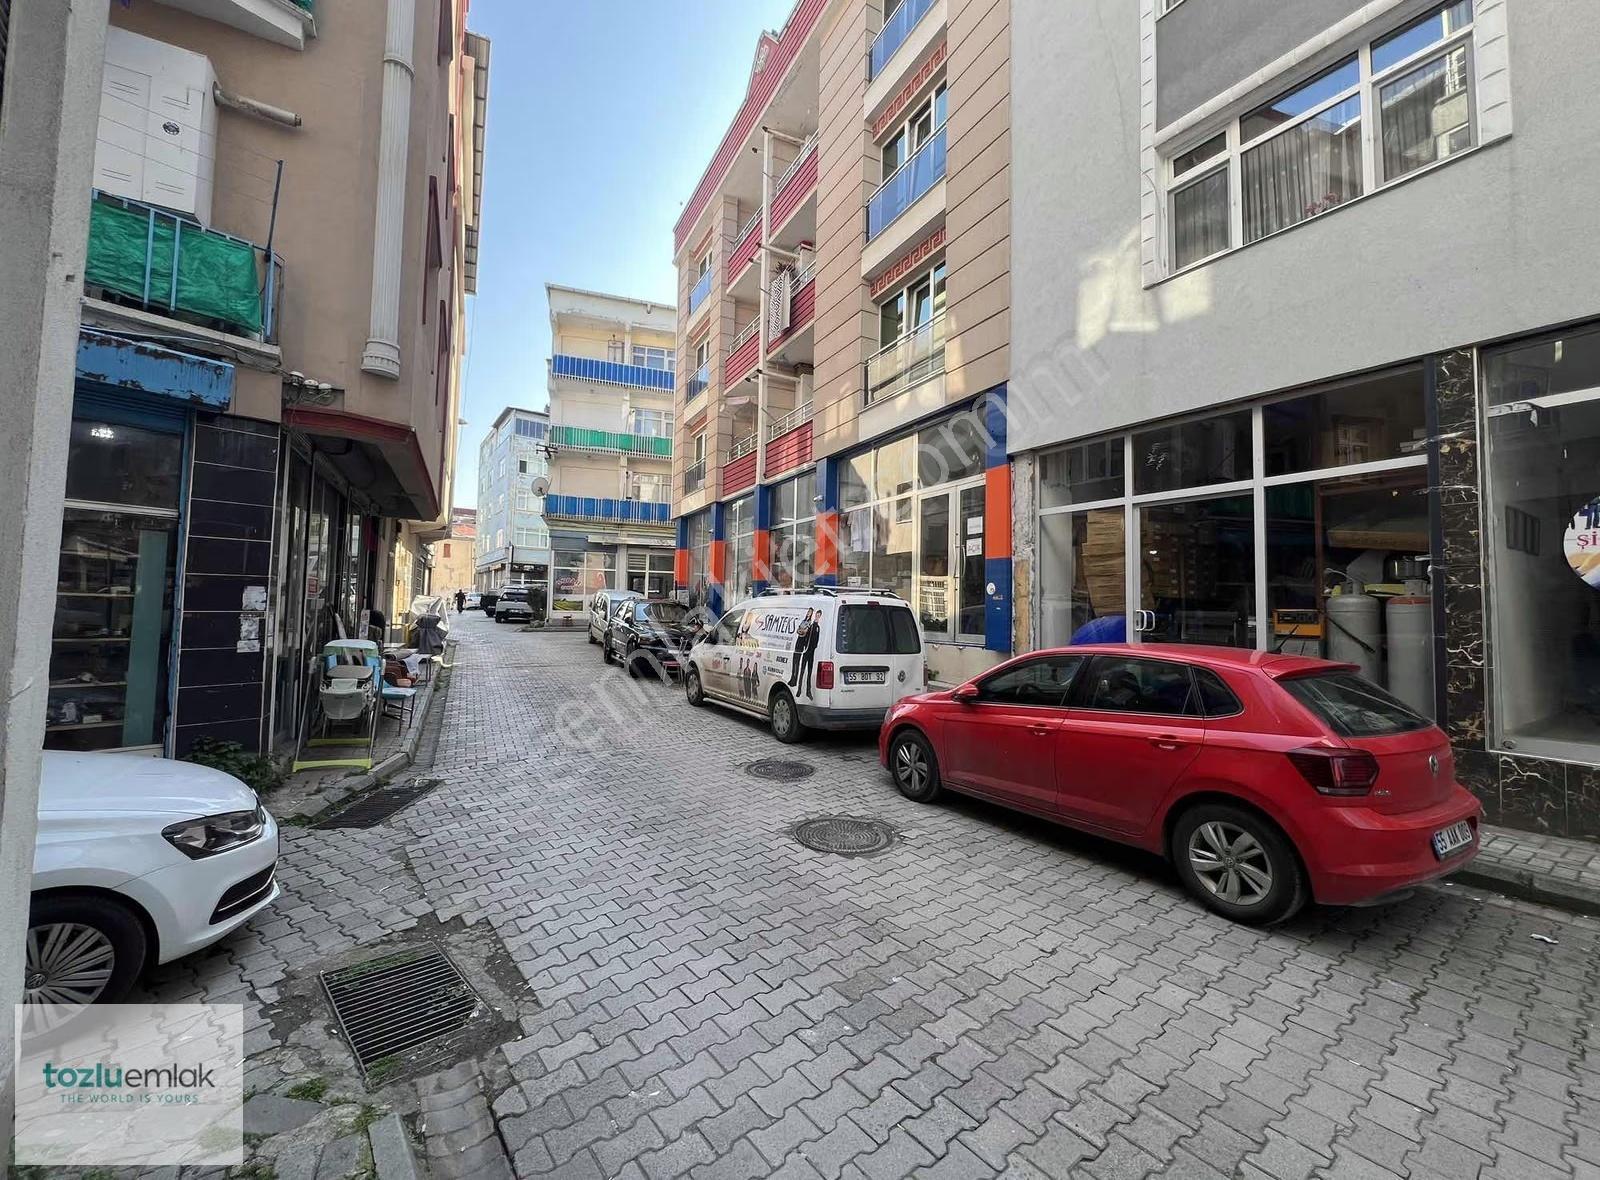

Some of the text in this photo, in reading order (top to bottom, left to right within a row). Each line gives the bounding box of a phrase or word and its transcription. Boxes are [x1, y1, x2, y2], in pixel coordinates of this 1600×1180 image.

[761, 614, 799, 634] SAMTEKS
[876, 672, 884, 681] 92
[1436, 832, 1448, 851] 55
